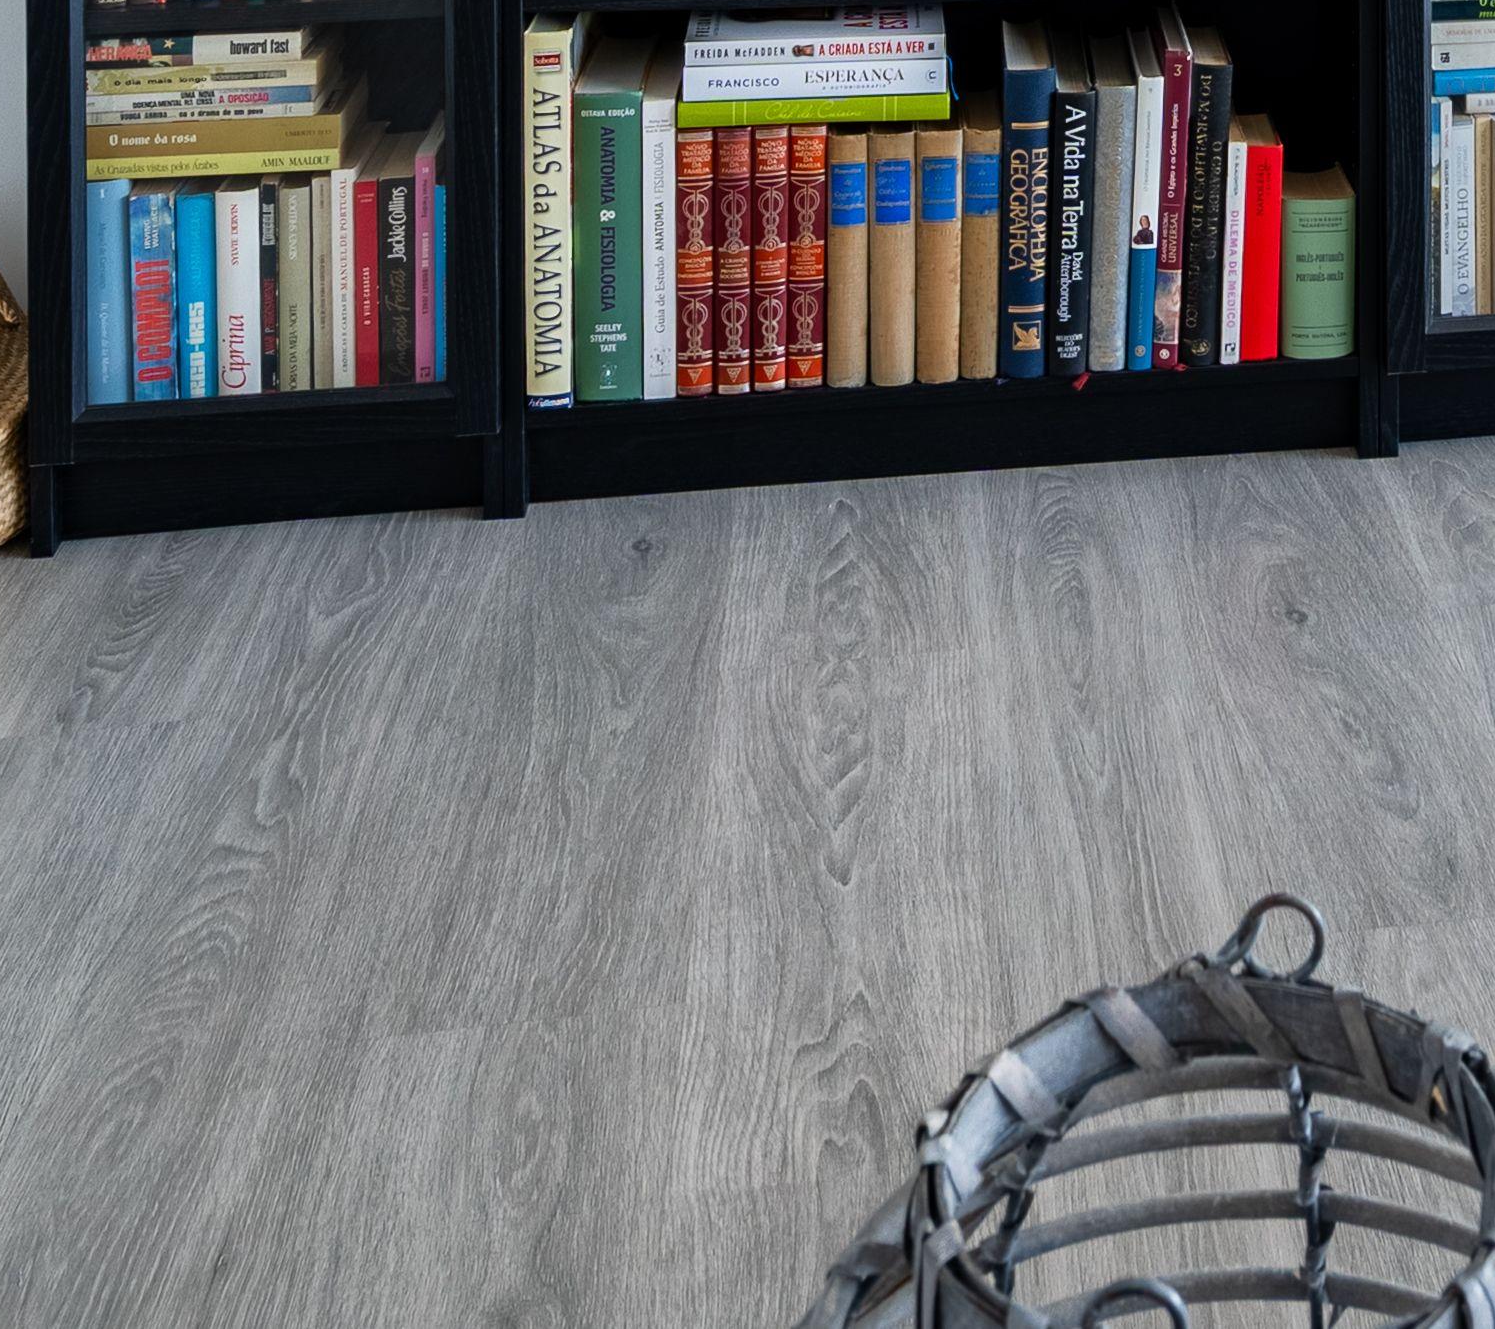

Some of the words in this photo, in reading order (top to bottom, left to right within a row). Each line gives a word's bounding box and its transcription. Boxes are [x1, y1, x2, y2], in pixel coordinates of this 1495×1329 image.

[230, 40, 267, 55] howard
[270, 39, 289, 53] fast
[695, 49, 729, 59] FREIDA
[735, 46, 785, 57] McFADDEN
[819, 44, 825, 56] A
[829, 43, 864, 56] CRIADA
[869, 40, 892, 54] ESTÁ
[896, 43, 903, 53] A
[906, 41, 924, 53] VER
[708, 78, 780, 89] FRANCISCO
[805, 68, 904, 85] ESPERANÇA
[581, 109, 605, 118] OITAVA
[608, 108, 635, 117] EDIÇÃO
[1065, 105, 1086, 122] A
[109, 135, 118, 146] O
[122, 137, 150, 146] nome
[155, 135, 167, 144] da
[171, 134, 196, 143] rosa
[533, 87, 561, 175] ATLAS
[1064, 125, 1085, 170] Vida
[600, 127, 615, 205] ANATOMIA
[533, 183, 549, 214] da
[1063, 174, 1080, 199] na
[600, 209, 615, 221] &
[1009, 150, 1028, 271] GEOGRAFICA
[1030, 148, 1048, 283] ENCICLOPEDIA
[1062, 202, 1083, 249] Terra
[601, 227, 615, 312] FISIOLOGIA
[1072, 251, 1083, 280] David
[1057, 253, 1072, 322] Attenborough
[533, 224, 562, 378] ANATOMIA
[590, 333, 627, 342] STEPHENS
[595, 324, 622, 332] SEELEY
[222, 314, 250, 389] Ciprina
[600, 344, 616, 352] TATE
